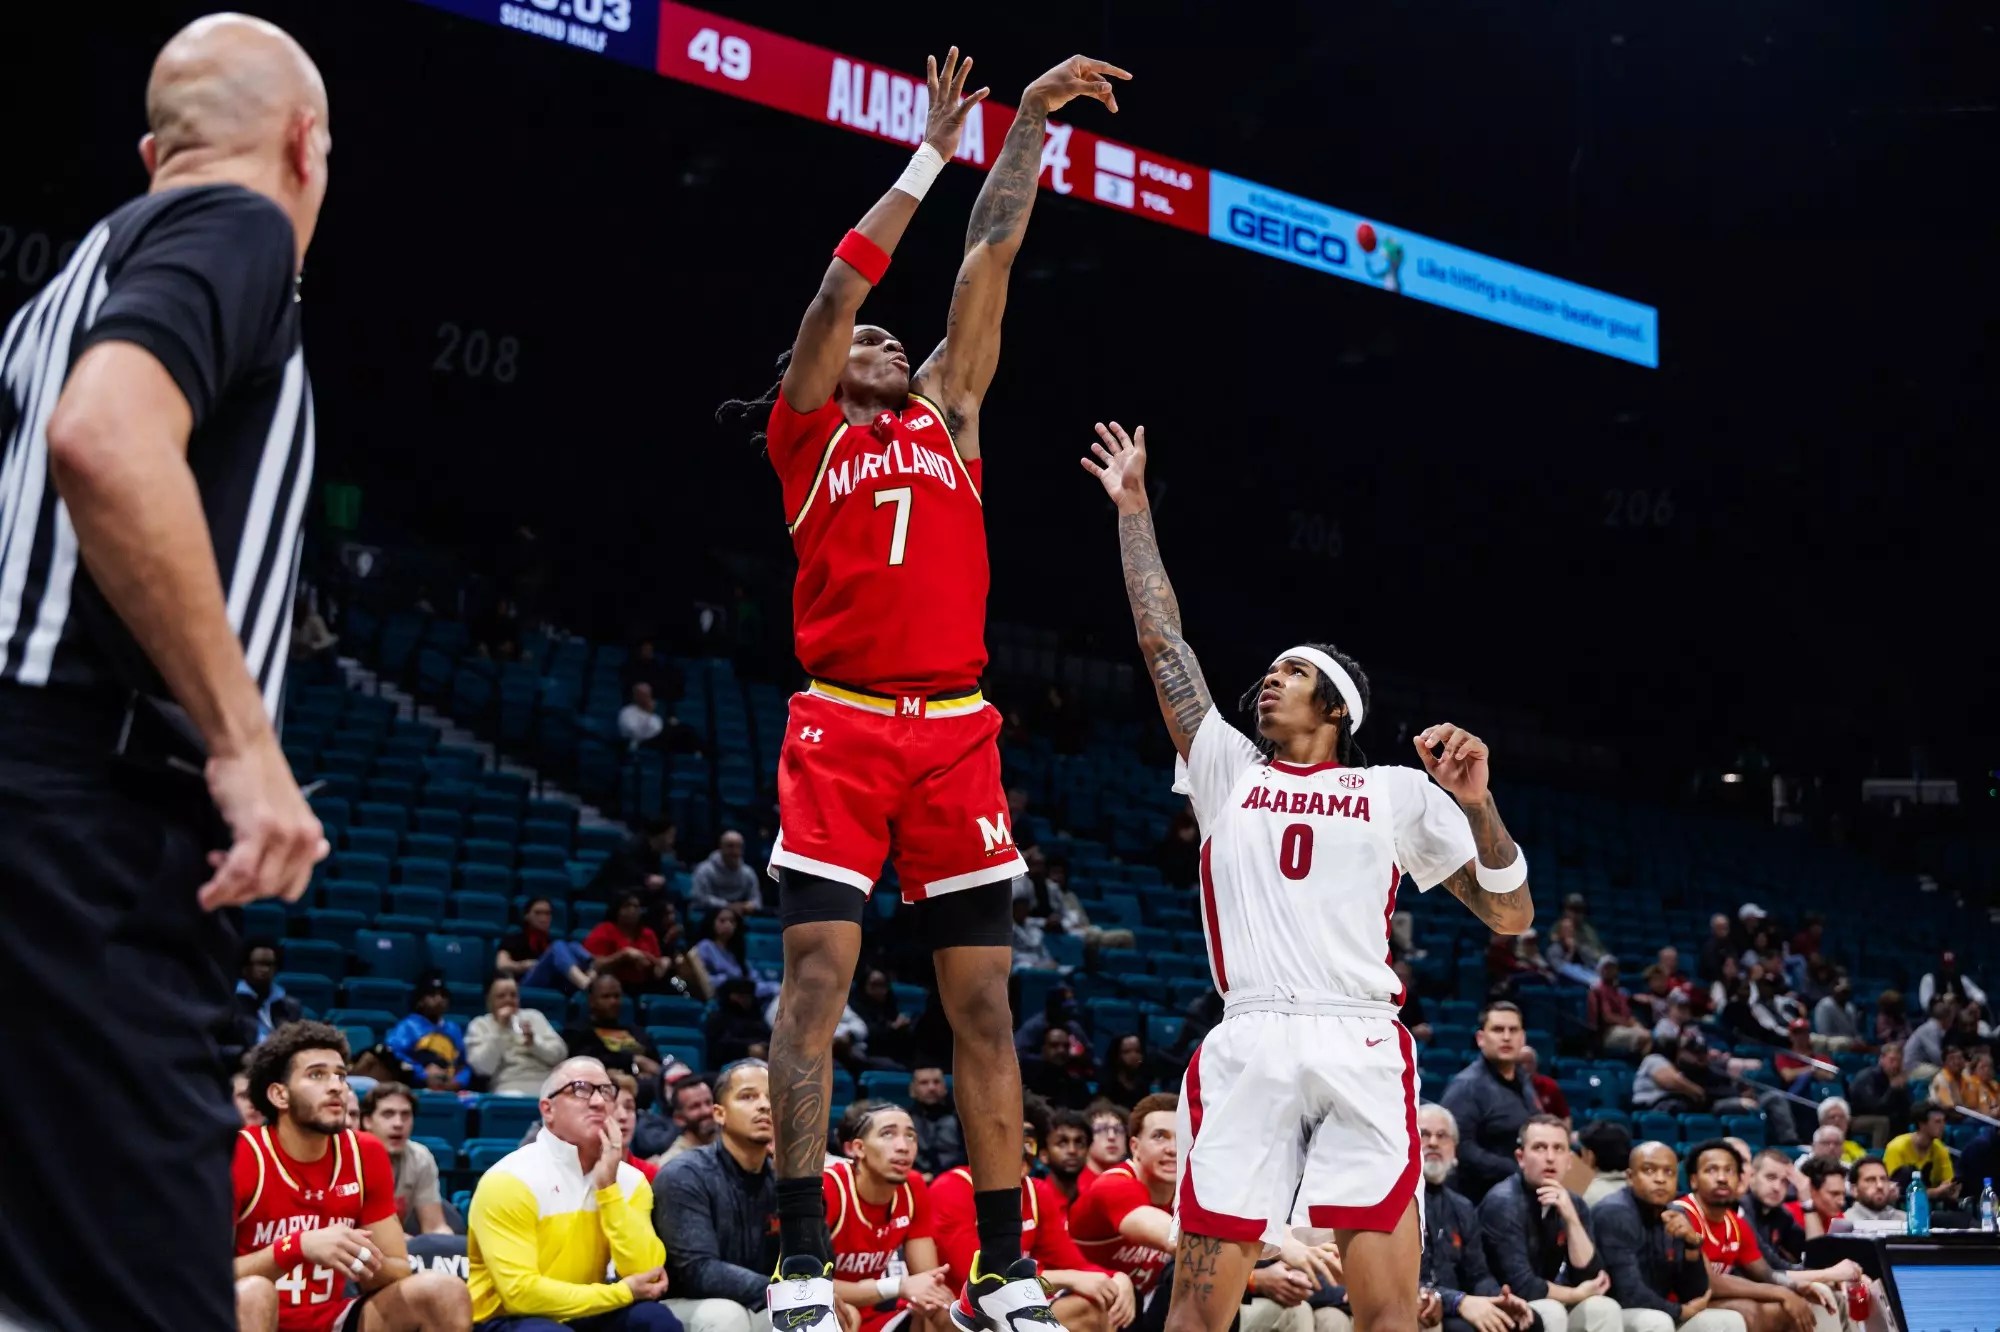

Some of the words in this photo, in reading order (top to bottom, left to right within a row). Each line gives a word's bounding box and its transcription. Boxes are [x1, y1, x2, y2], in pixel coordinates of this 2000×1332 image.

[499, 2, 567, 41] SECOND
[566, 22, 609, 53] HALF
[687, 27, 752, 81] 49
[827, 57, 985, 165] ALABAA
[1139, 160, 1193, 191] FOULS
[1228, 206, 1347, 266] GEICO
[431, 320, 521, 384] 208
[828, 440, 956, 503] MARYLAND
[874, 486, 912, 566] 7
[901, 696, 920, 715] M
[1241, 786, 1370, 822] ALABAMA
[1338, 773, 1365, 789] SEC
[975, 812, 1013, 852] M
[1279, 823, 1314, 880] 0
[275, 1262, 334, 1305] 45
